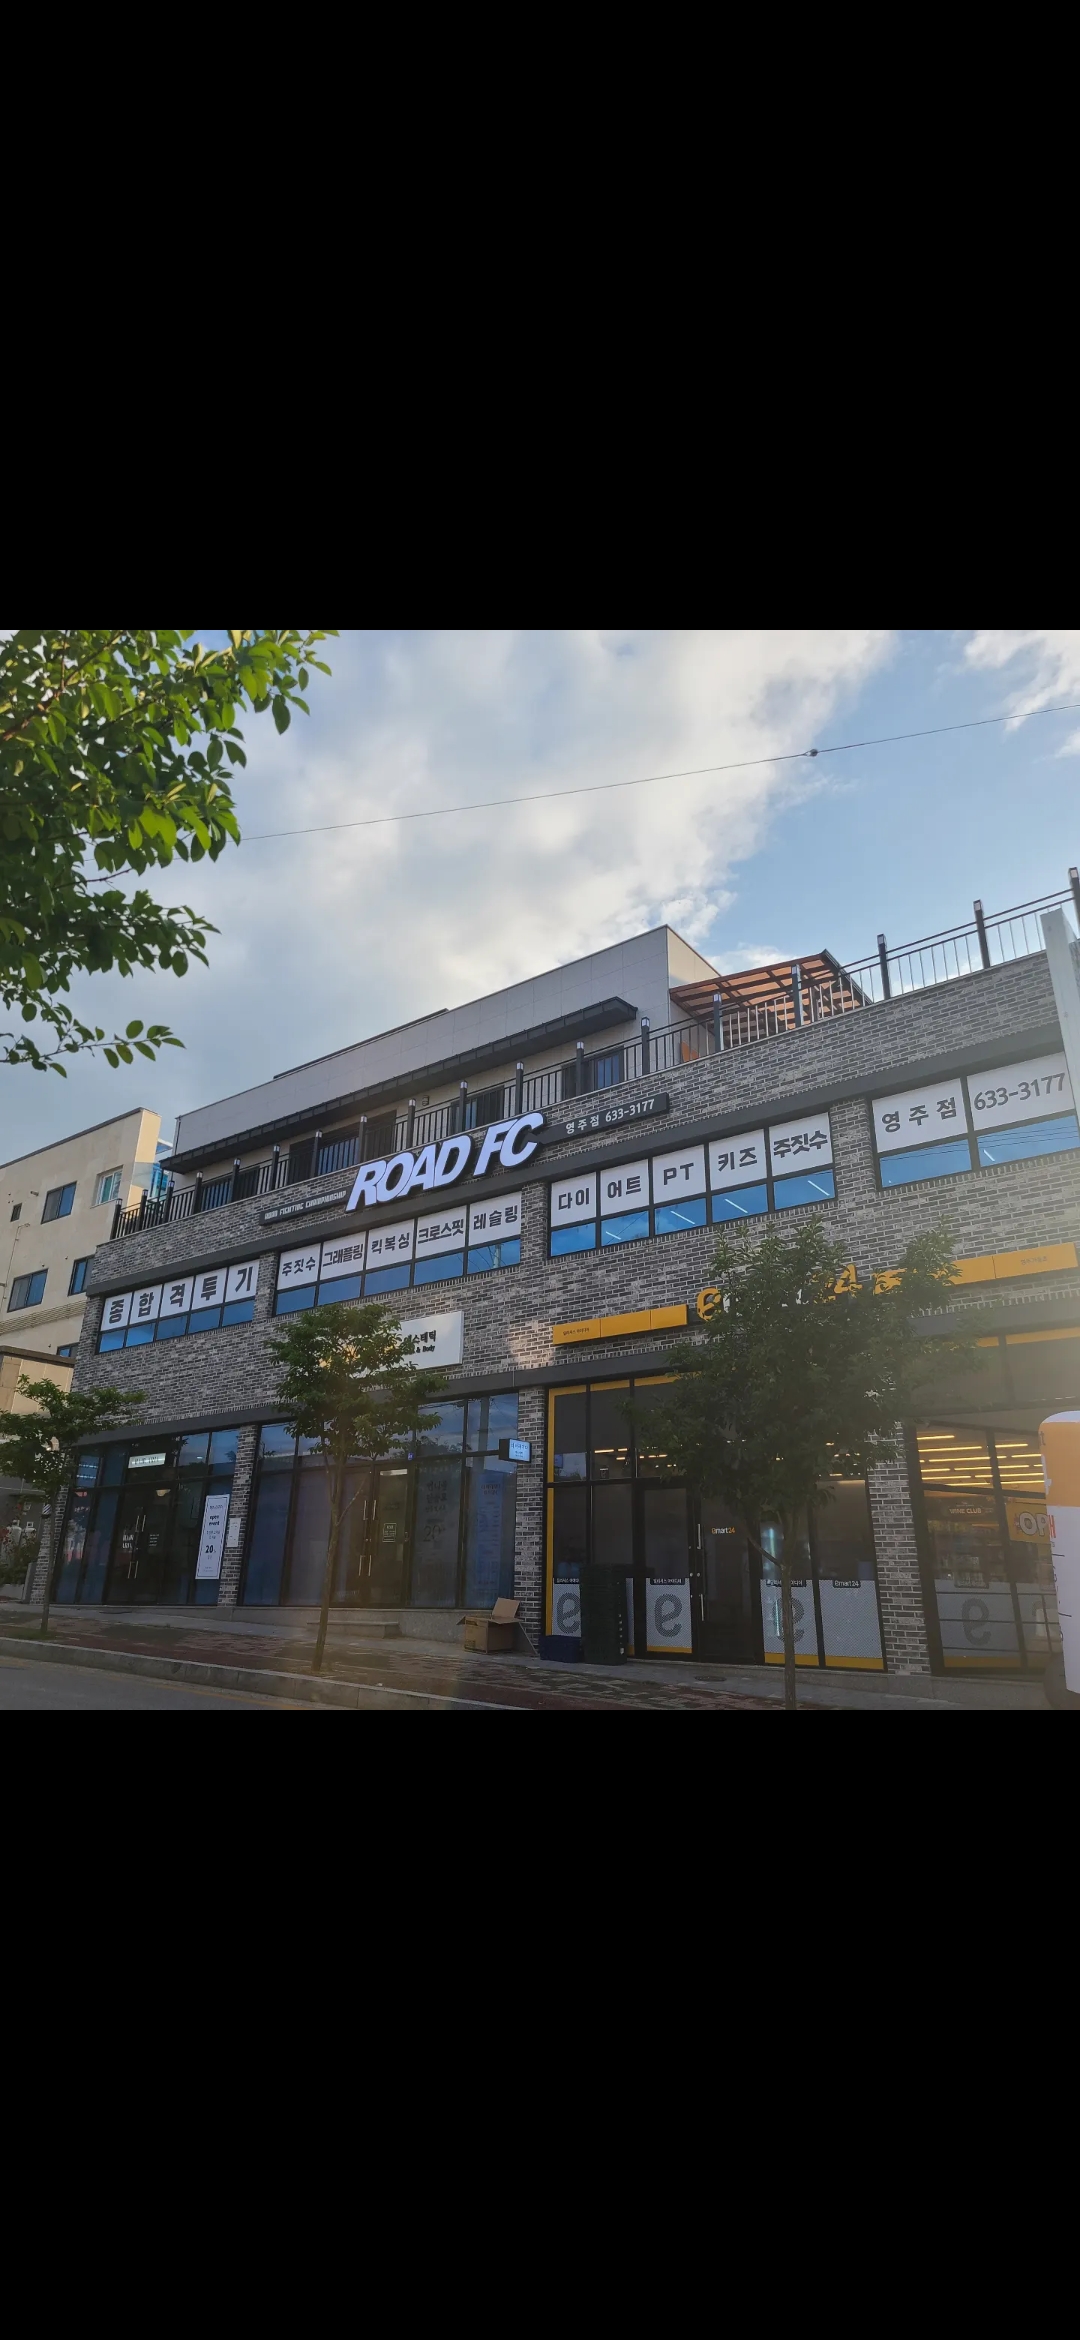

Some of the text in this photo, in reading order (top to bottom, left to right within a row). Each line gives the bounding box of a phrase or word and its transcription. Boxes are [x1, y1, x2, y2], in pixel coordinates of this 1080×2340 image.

[565, 1098, 655, 1135] 영주점 633-3177
[881, 1072, 1066, 1133] 영주점 633-3177
[346, 1112, 543, 1212] ROAD FC
[663, 1162, 695, 1186] PT
[717, 1147, 758, 1172] 키즈
[773, 1130, 829, 1158] 주짓수
[282, 1205, 519, 1277] 주짓수 그래플링 킥복싱 크로스핏 레슬링
[108, 1265, 254, 1324] 종합격투기
[834, 1580, 860, 1588] emart24
